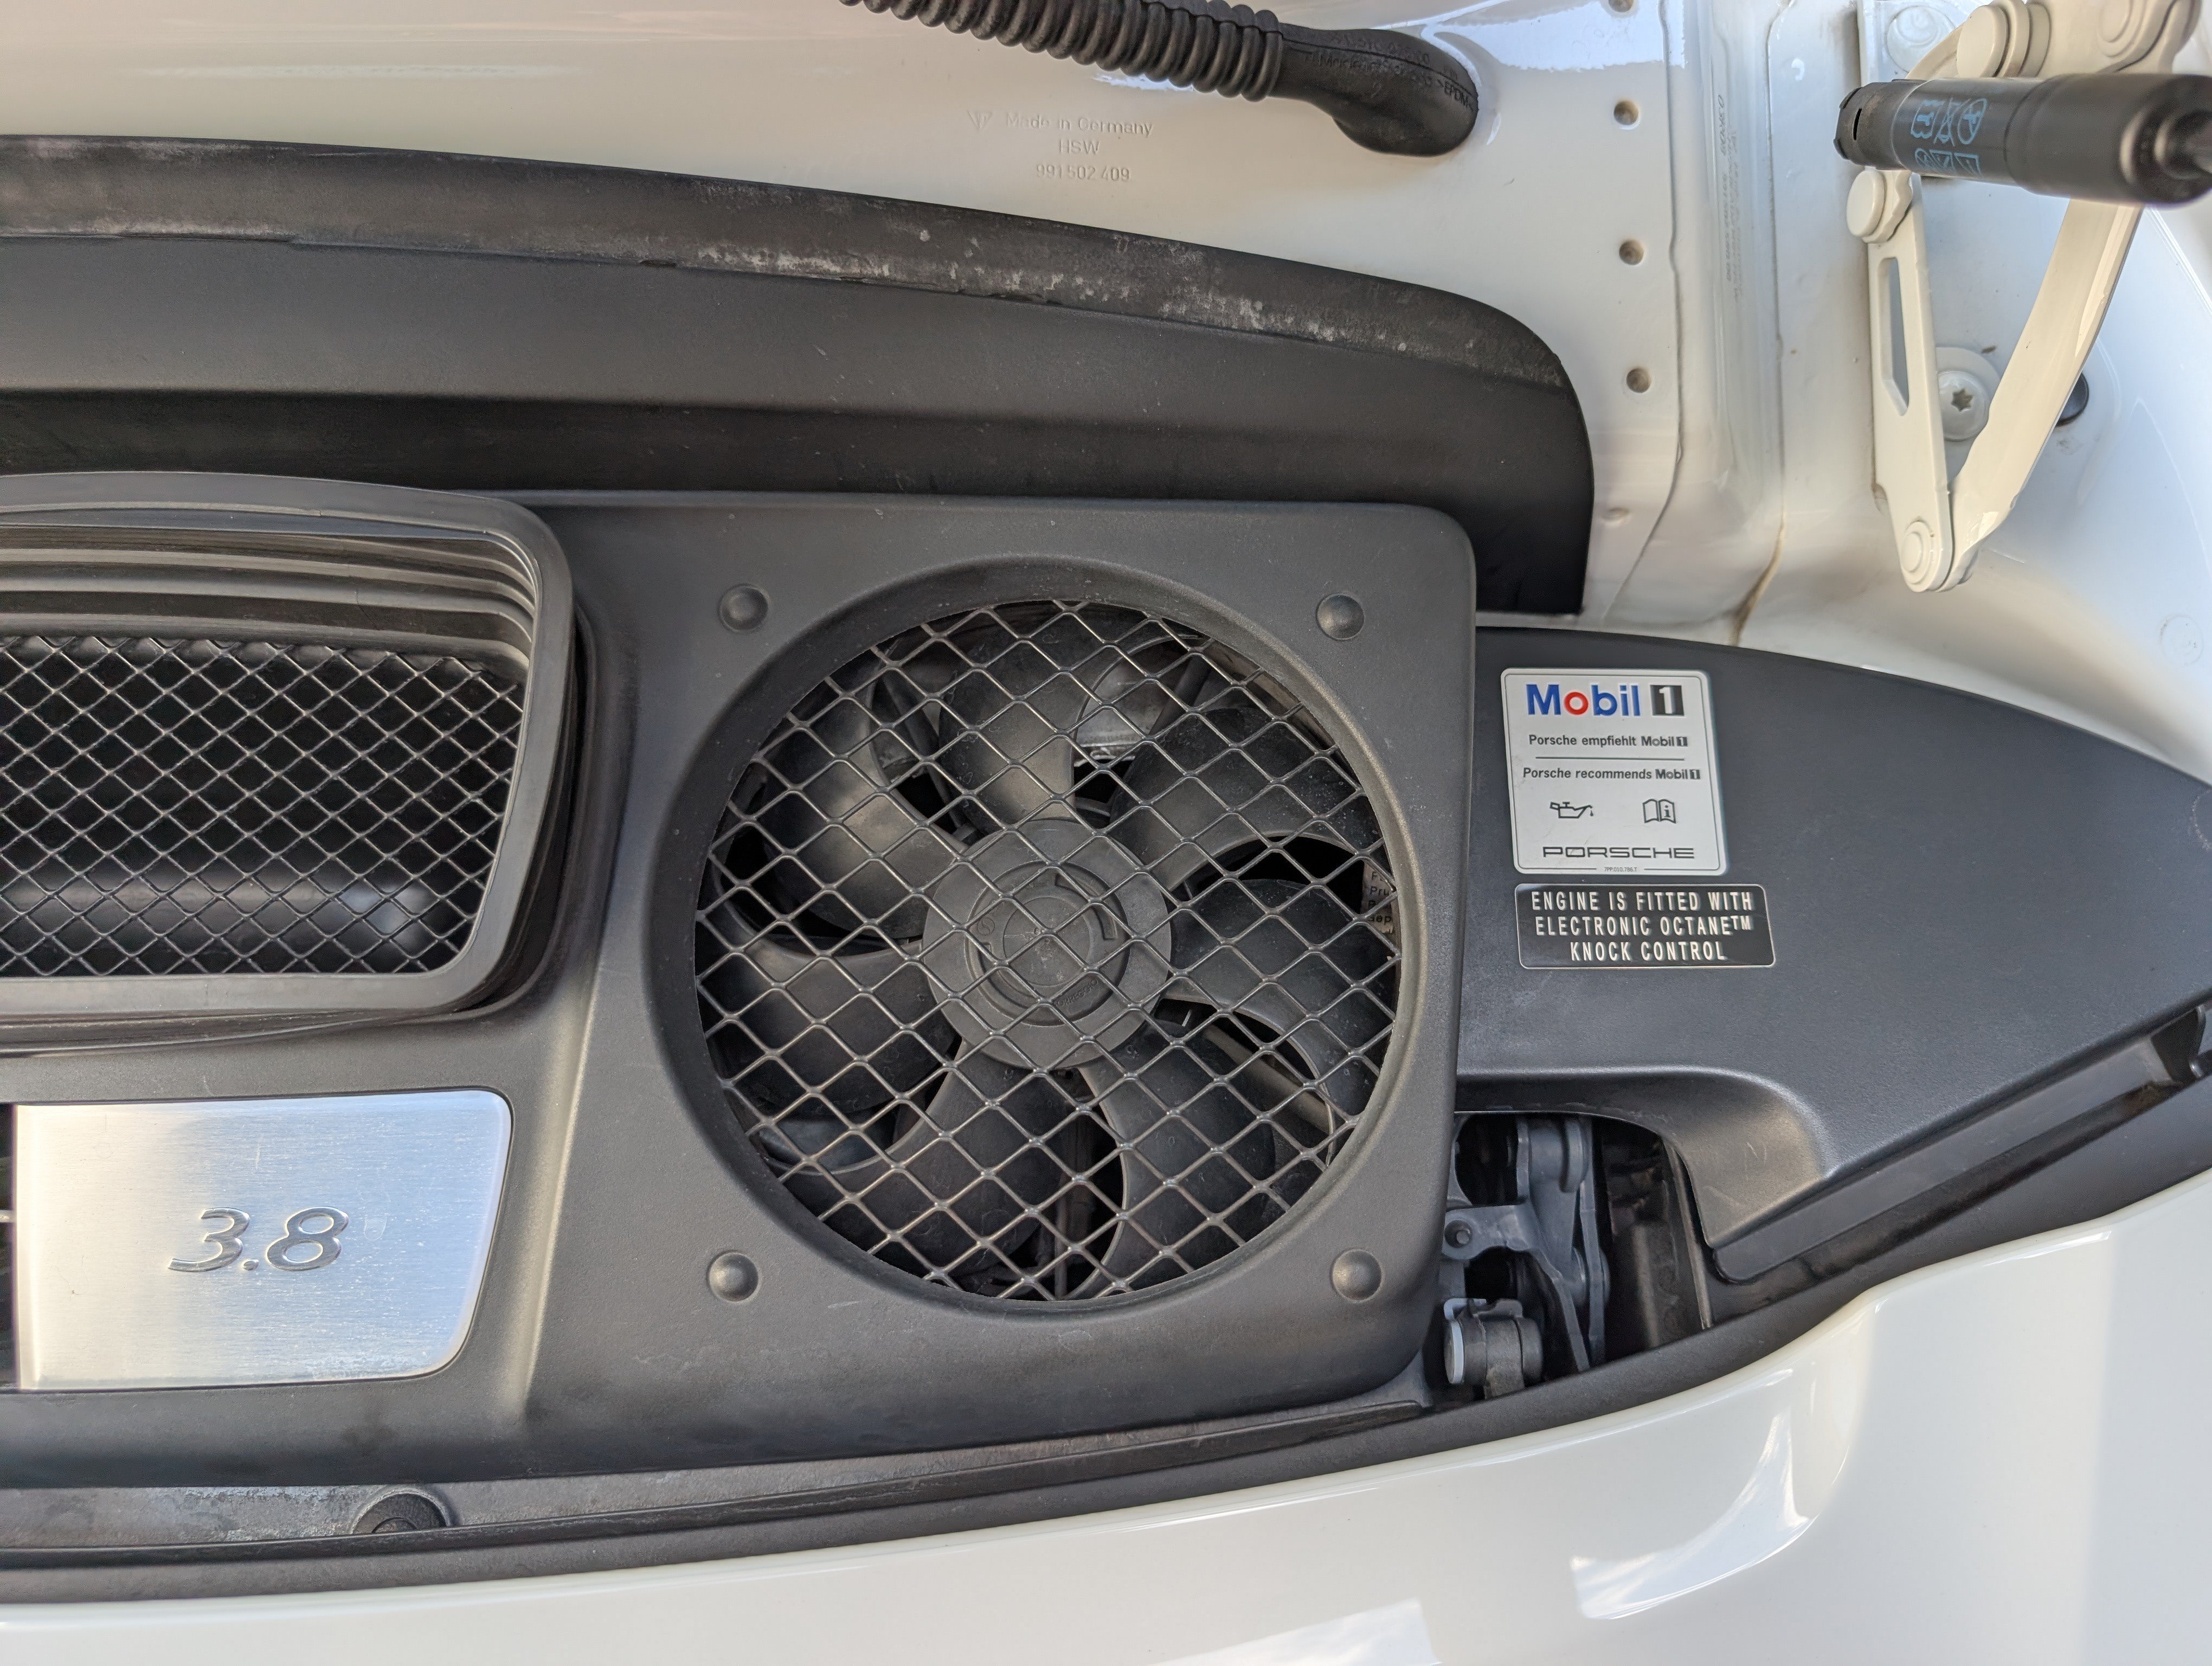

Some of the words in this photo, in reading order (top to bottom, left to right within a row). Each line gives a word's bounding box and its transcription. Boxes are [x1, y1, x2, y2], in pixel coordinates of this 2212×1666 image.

[1078, 116, 1154, 137] Germany
[1525, 684, 1641, 716] Mobil
[1529, 734, 1577, 746] Porsche
[1581, 735, 1636, 747] empfiehlt
[1641, 736, 1675, 747] Mobil
[1523, 767, 1571, 779] Porsche
[1576, 768, 1652, 779] recommends
[1655, 768, 1688, 780] Mobil
[1543, 846, 1695, 858] PORSCHE
[1531, 891, 1600, 911] ENGINE
[1609, 892, 1626, 911] IS
[1636, 892, 1700, 911] FITTED
[1708, 892, 1754, 911] WITH
[1536, 917, 1650, 936] ELECTRONIC
[1570, 941, 1631, 962] KNOCK
[1641, 941, 1727, 961] CONTROL
[168, 1206, 349, 1272] 3.8
